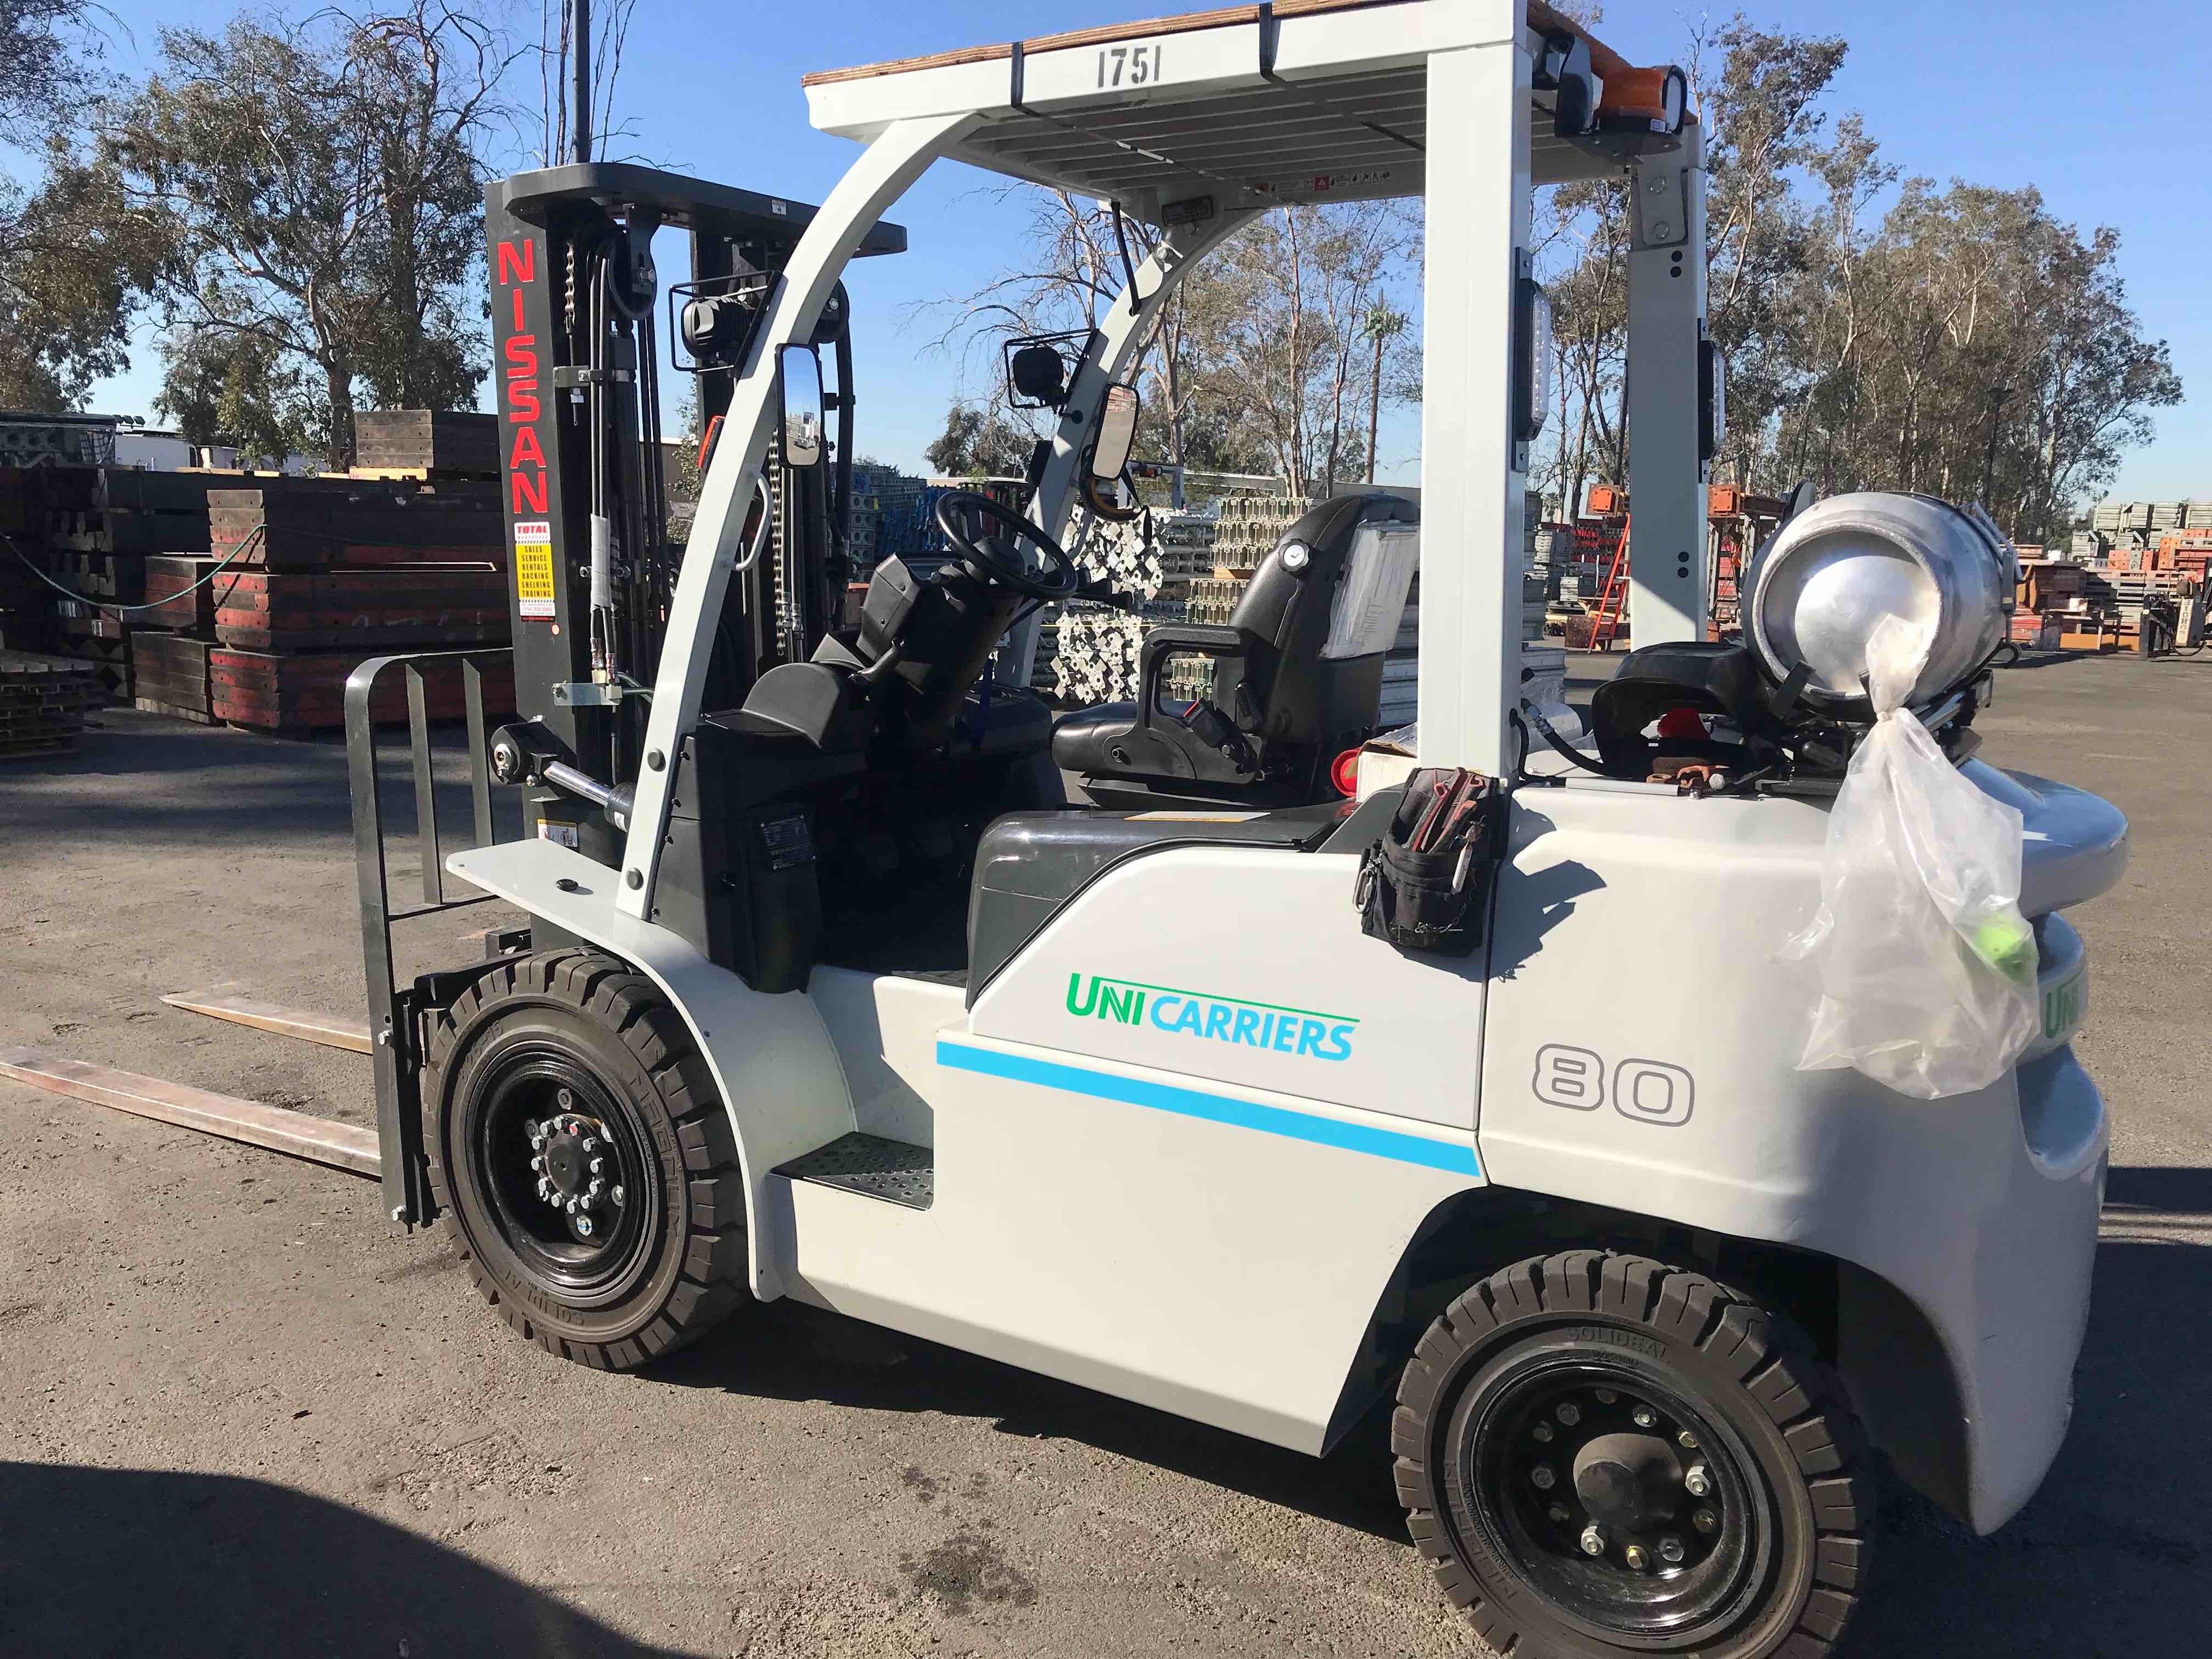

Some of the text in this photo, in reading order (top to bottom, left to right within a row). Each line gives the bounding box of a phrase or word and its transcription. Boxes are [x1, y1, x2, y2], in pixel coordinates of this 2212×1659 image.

[497, 238, 548, 514] NISSAN
[517, 525, 547, 533] TOTAL
[1532, 1043, 1695, 1127] 80
